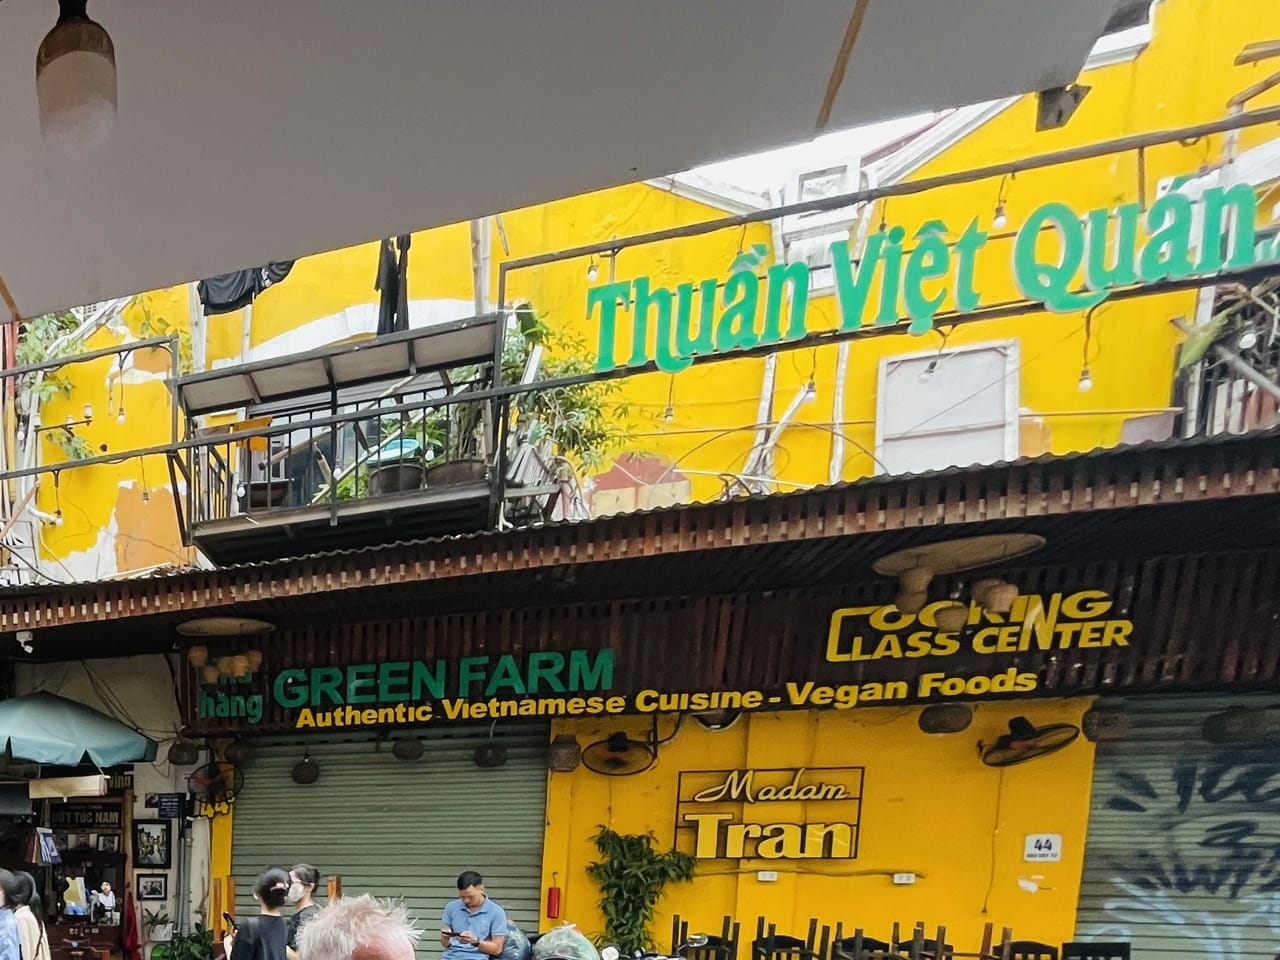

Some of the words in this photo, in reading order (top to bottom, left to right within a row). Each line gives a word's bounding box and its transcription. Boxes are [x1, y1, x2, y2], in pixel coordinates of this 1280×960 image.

[585, 243, 811, 373] Thuần
[830, 214, 988, 336] Việt
[1014, 174, 1258, 312] Quán
[273, 657, 447, 709] GREEN
[459, 648, 616, 696] FARM
[296, 705, 433, 729] Authentic
[442, 696, 626, 720] Vietnamese
[918, 667, 1038, 698] Foods
[694, 768, 850, 803] Madam
[684, 813, 851, 859] Tran
[1034, 839, 1052, 850] 44
